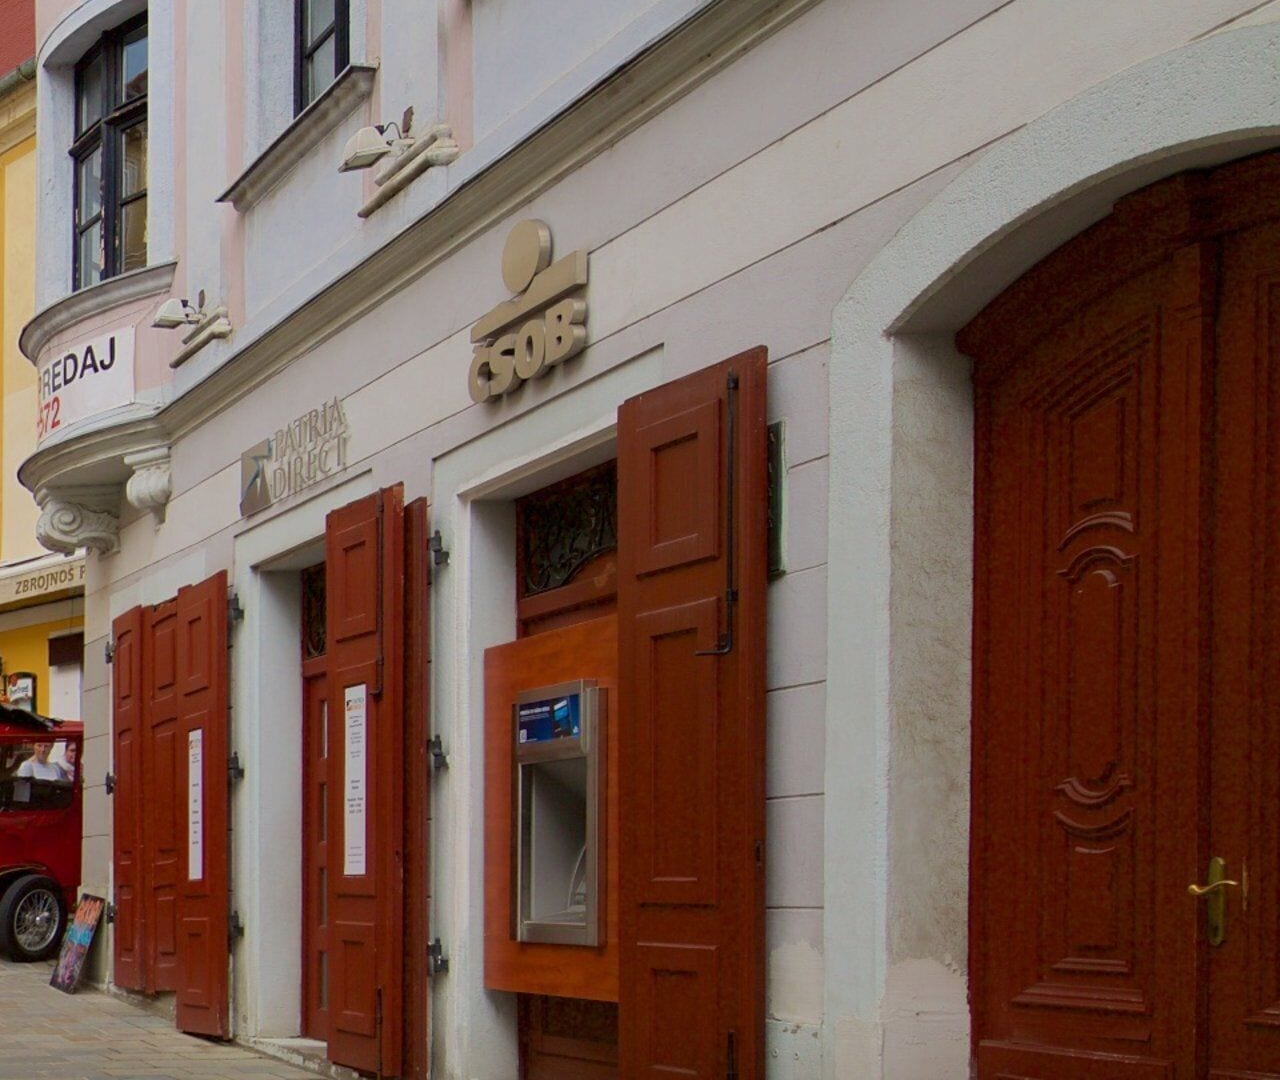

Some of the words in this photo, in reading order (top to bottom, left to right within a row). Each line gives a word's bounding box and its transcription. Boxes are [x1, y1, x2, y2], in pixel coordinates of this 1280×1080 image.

[39, 335, 116, 400] REDAJ
[273, 395, 348, 464] PATRIA
[272, 430, 349, 500] DIRECT
